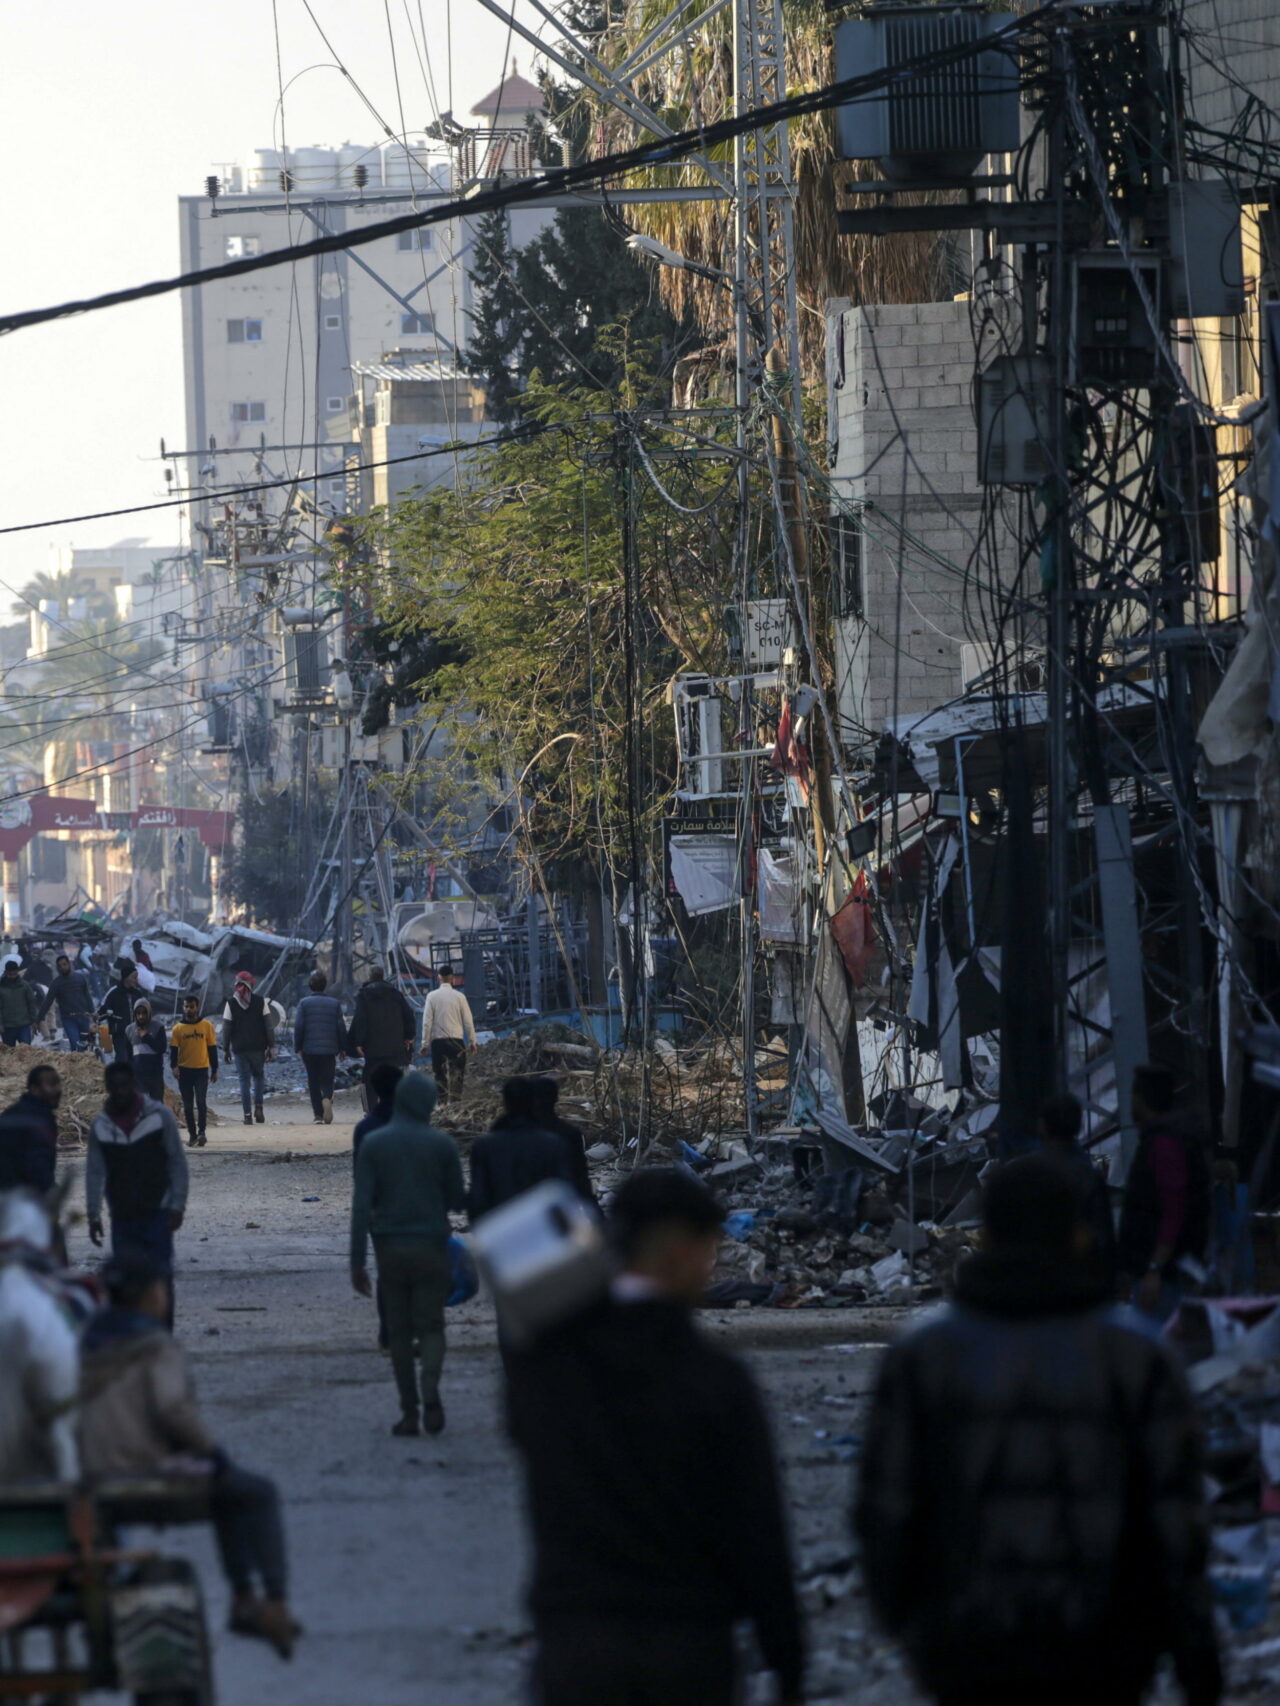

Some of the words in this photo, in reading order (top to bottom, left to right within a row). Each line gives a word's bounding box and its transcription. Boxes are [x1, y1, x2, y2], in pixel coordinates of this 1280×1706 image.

[759, 636, 781, 648] 010
[139, 810, 176, 827] رافقتكم
[670, 821, 704, 834] سمارت
